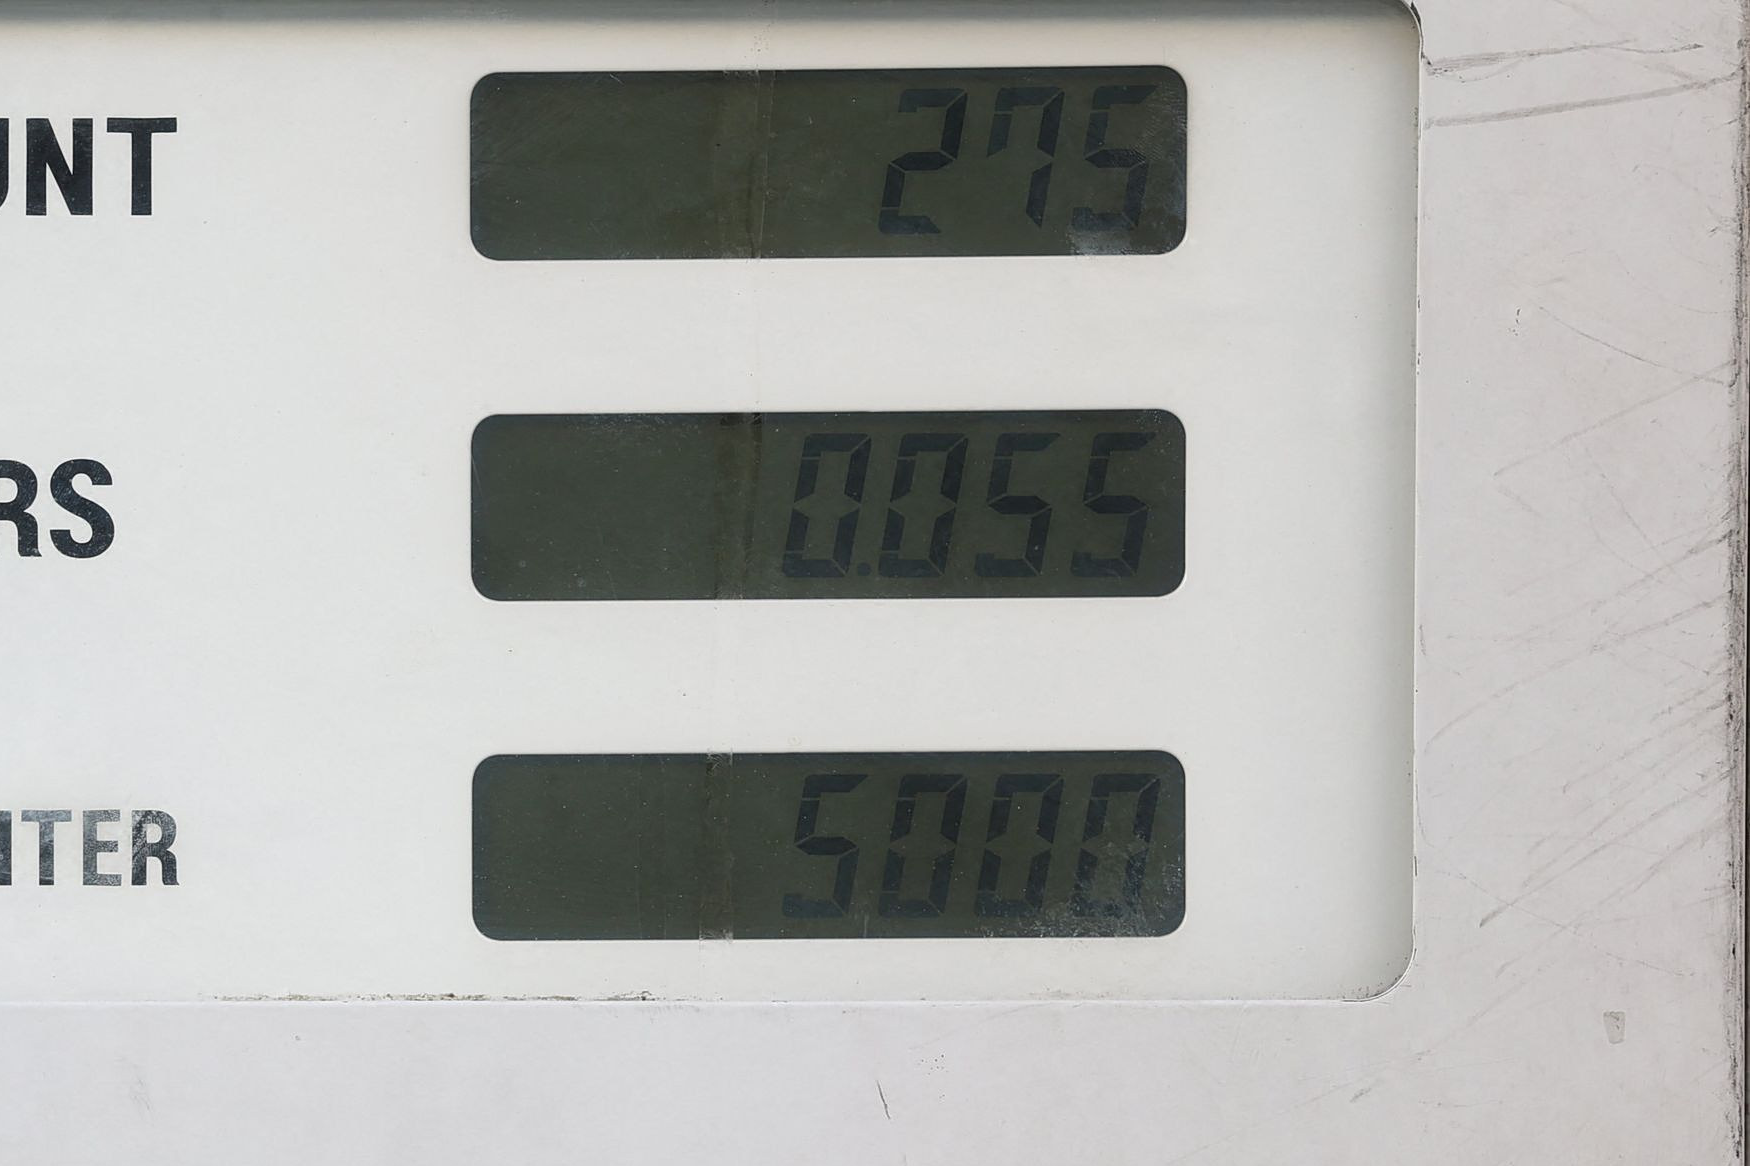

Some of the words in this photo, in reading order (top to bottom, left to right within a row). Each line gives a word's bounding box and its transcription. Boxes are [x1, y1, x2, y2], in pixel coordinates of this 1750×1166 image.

[878, 84, 1158, 236] 275
[781, 431, 1158, 580] 0.055
[781, 773, 1161, 920] 5000
